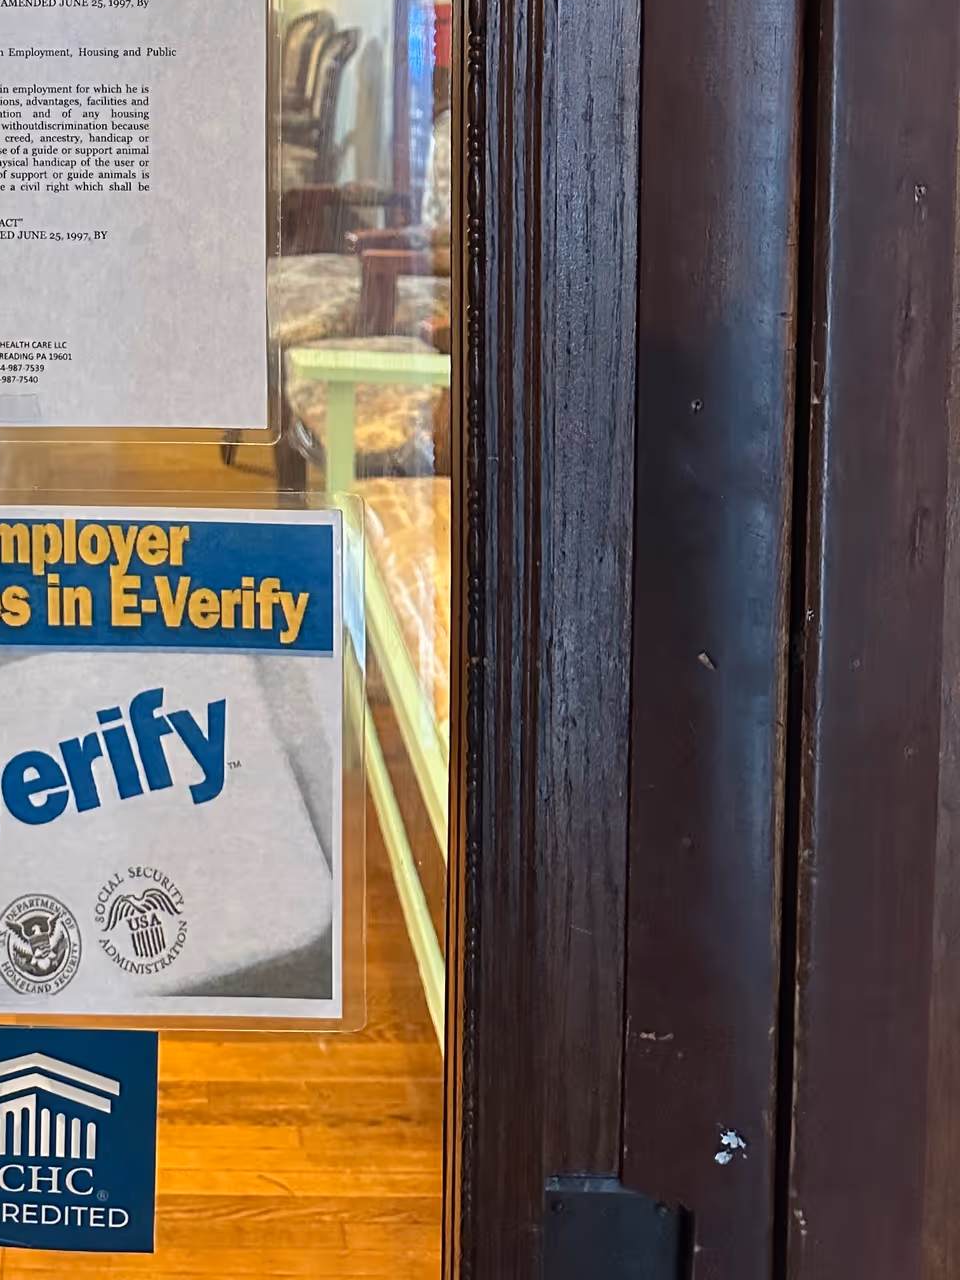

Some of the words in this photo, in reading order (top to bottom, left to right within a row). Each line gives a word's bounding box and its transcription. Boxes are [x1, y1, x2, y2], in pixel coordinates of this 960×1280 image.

[8, 47, 72, 59] Employment,
[78, 47, 119, 58] Housing
[122, 46, 141, 56] and
[146, 46, 176, 56] Public
[36, 352, 46, 360] PA
[49, 352, 72, 360] 19601
[46, 573, 94, 627] in
[110, 575, 309, 644] E-Verify
[95, 873, 124, 923] SOCIAL
[128, 867, 184, 906] SECURITY
[6, 898, 67, 921] DEPARTMENT
[64, 917, 76, 931] OF
[126, 913, 162, 932] USA
[53, 942, 78, 988] SECURITY
[99, 920, 187, 975] ADMINISTRATION
[1, 960, 52, 995] HOMELAND
